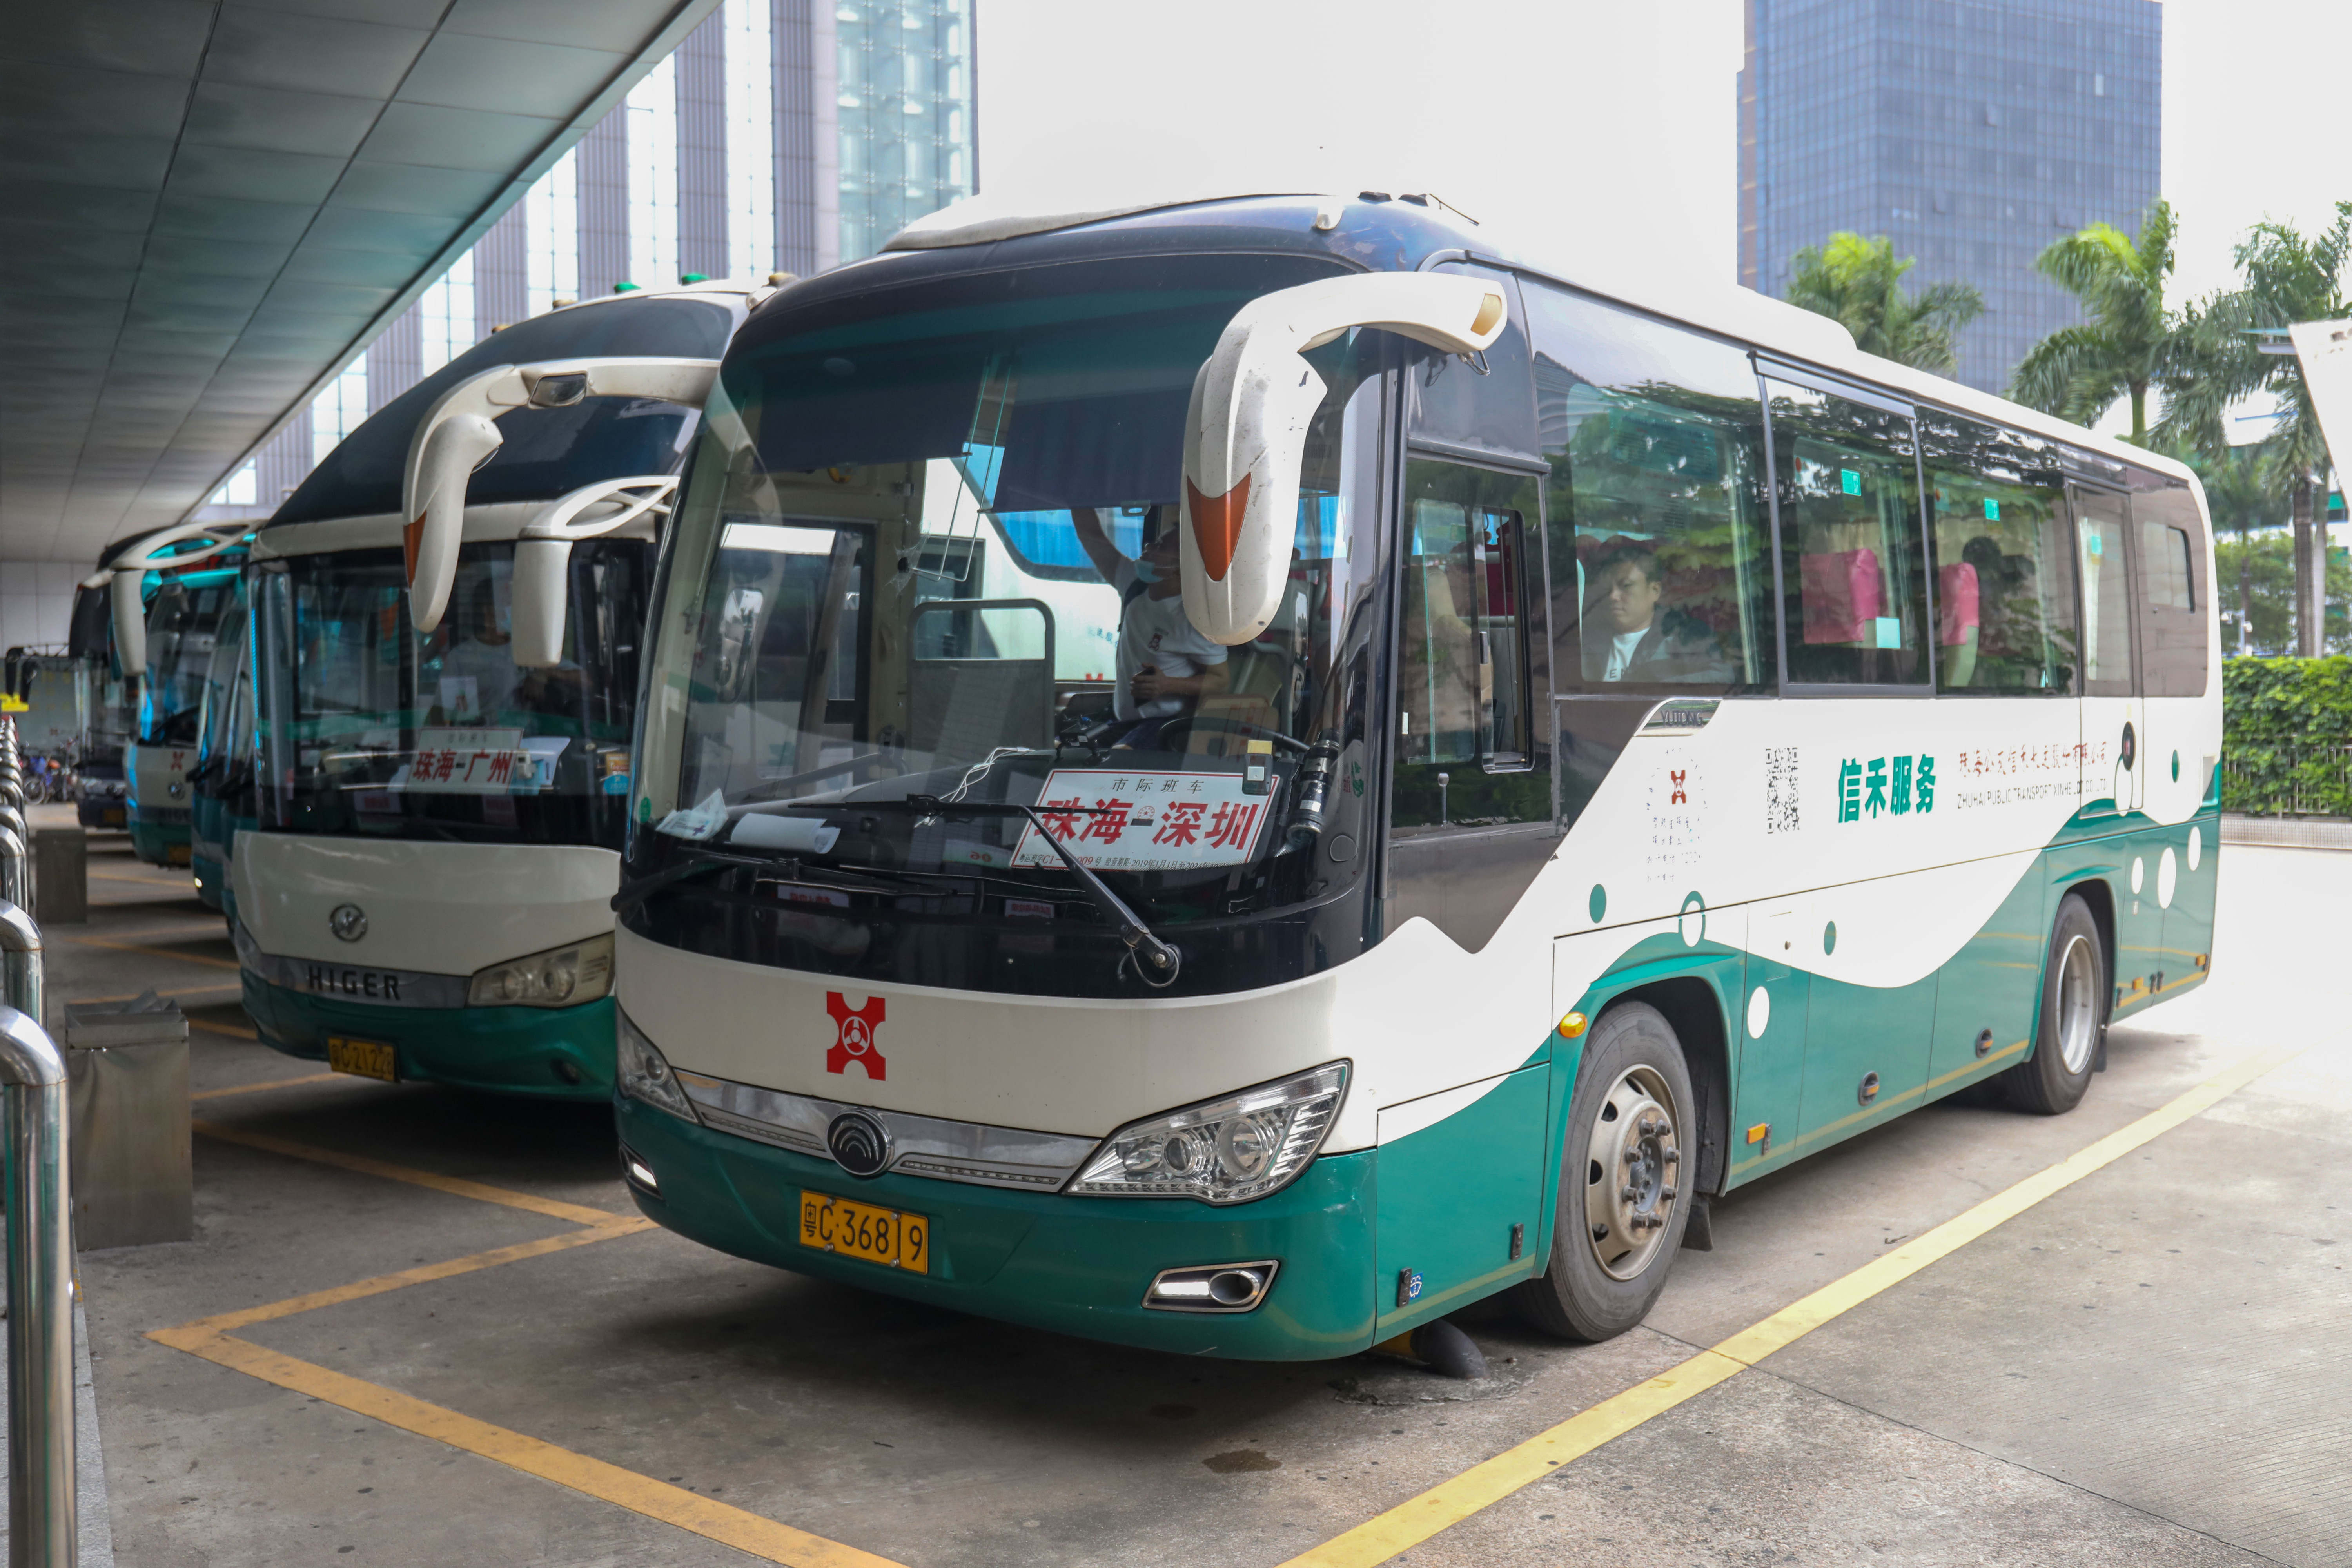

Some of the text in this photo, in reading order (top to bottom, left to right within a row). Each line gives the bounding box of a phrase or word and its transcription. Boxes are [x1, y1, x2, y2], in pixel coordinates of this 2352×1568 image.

[1661, 710, 1702, 728] YUTONG
[1112, 777, 1203, 794] 市际班车
[1838, 753, 1936, 823] 信禾服务
[1987, 789, 2011, 805] PUBLIC
[2014, 784, 2051, 801] TRANSPORT
[2054, 782, 2071, 796] XINHE
[308, 966, 401, 1001] HIGER
